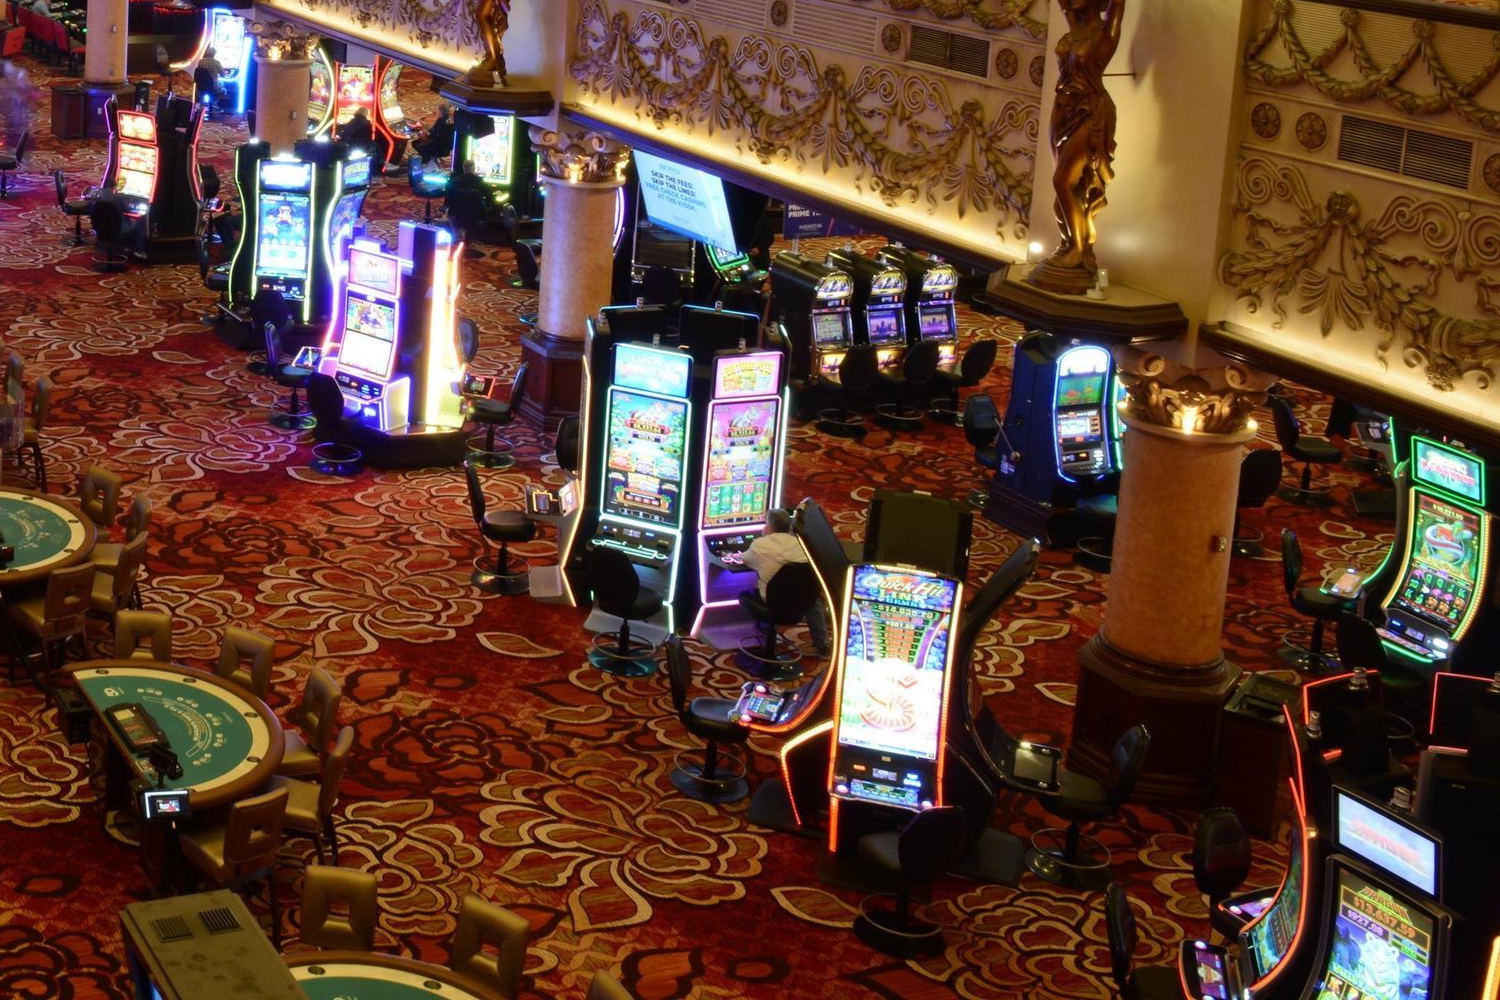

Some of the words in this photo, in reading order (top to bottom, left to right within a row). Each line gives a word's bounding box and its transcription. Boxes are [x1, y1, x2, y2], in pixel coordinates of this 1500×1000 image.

[651, 170, 665, 179] SKIP
[665, 175, 678, 184] THE
[651, 177, 665, 186] SKIP
[666, 182, 678, 191] THE
[788, 209, 810, 218] PRIME
[862, 574, 914, 591] Quick
[915, 581, 947, 597] Hit
